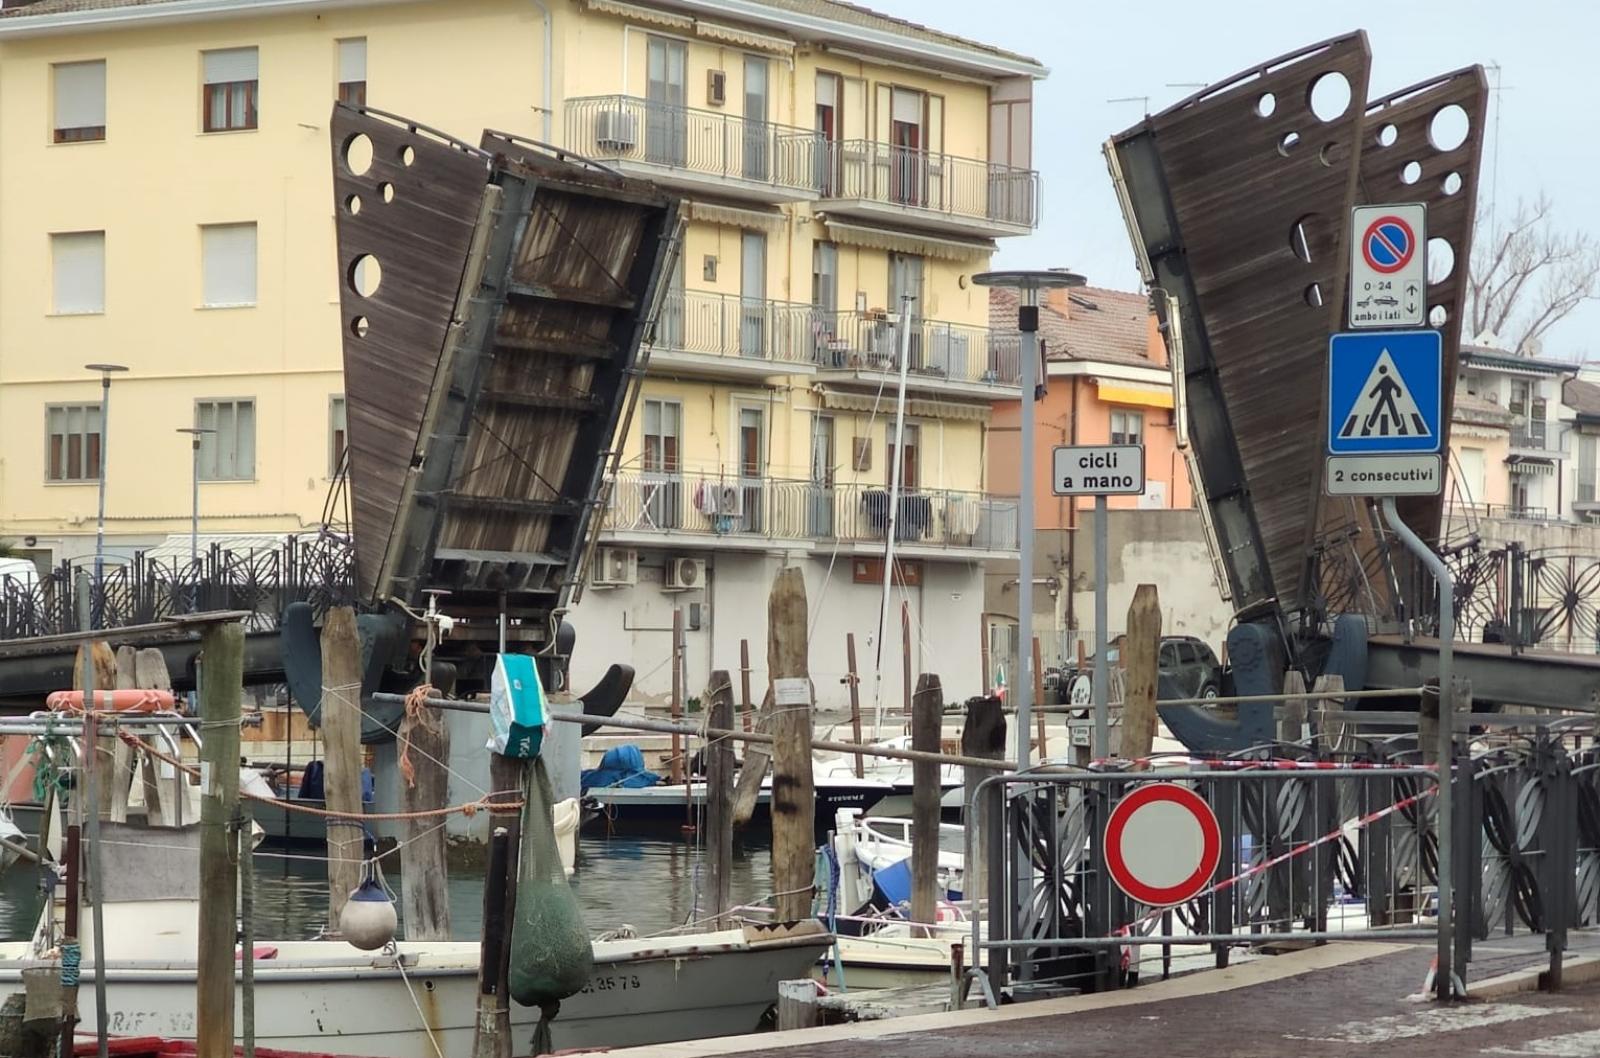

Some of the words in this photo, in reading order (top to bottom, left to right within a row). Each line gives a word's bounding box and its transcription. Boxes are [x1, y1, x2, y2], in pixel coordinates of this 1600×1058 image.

[1355, 311, 1377, 321] ambo
[1385, 310, 1400, 320] lati
[1079, 452, 1117, 468] cicli
[1335, 470, 1344, 482] 2
[1351, 468, 1433, 482] consecutivi
[1063, 476, 1073, 488] a
[1083, 476, 1133, 488] mano
